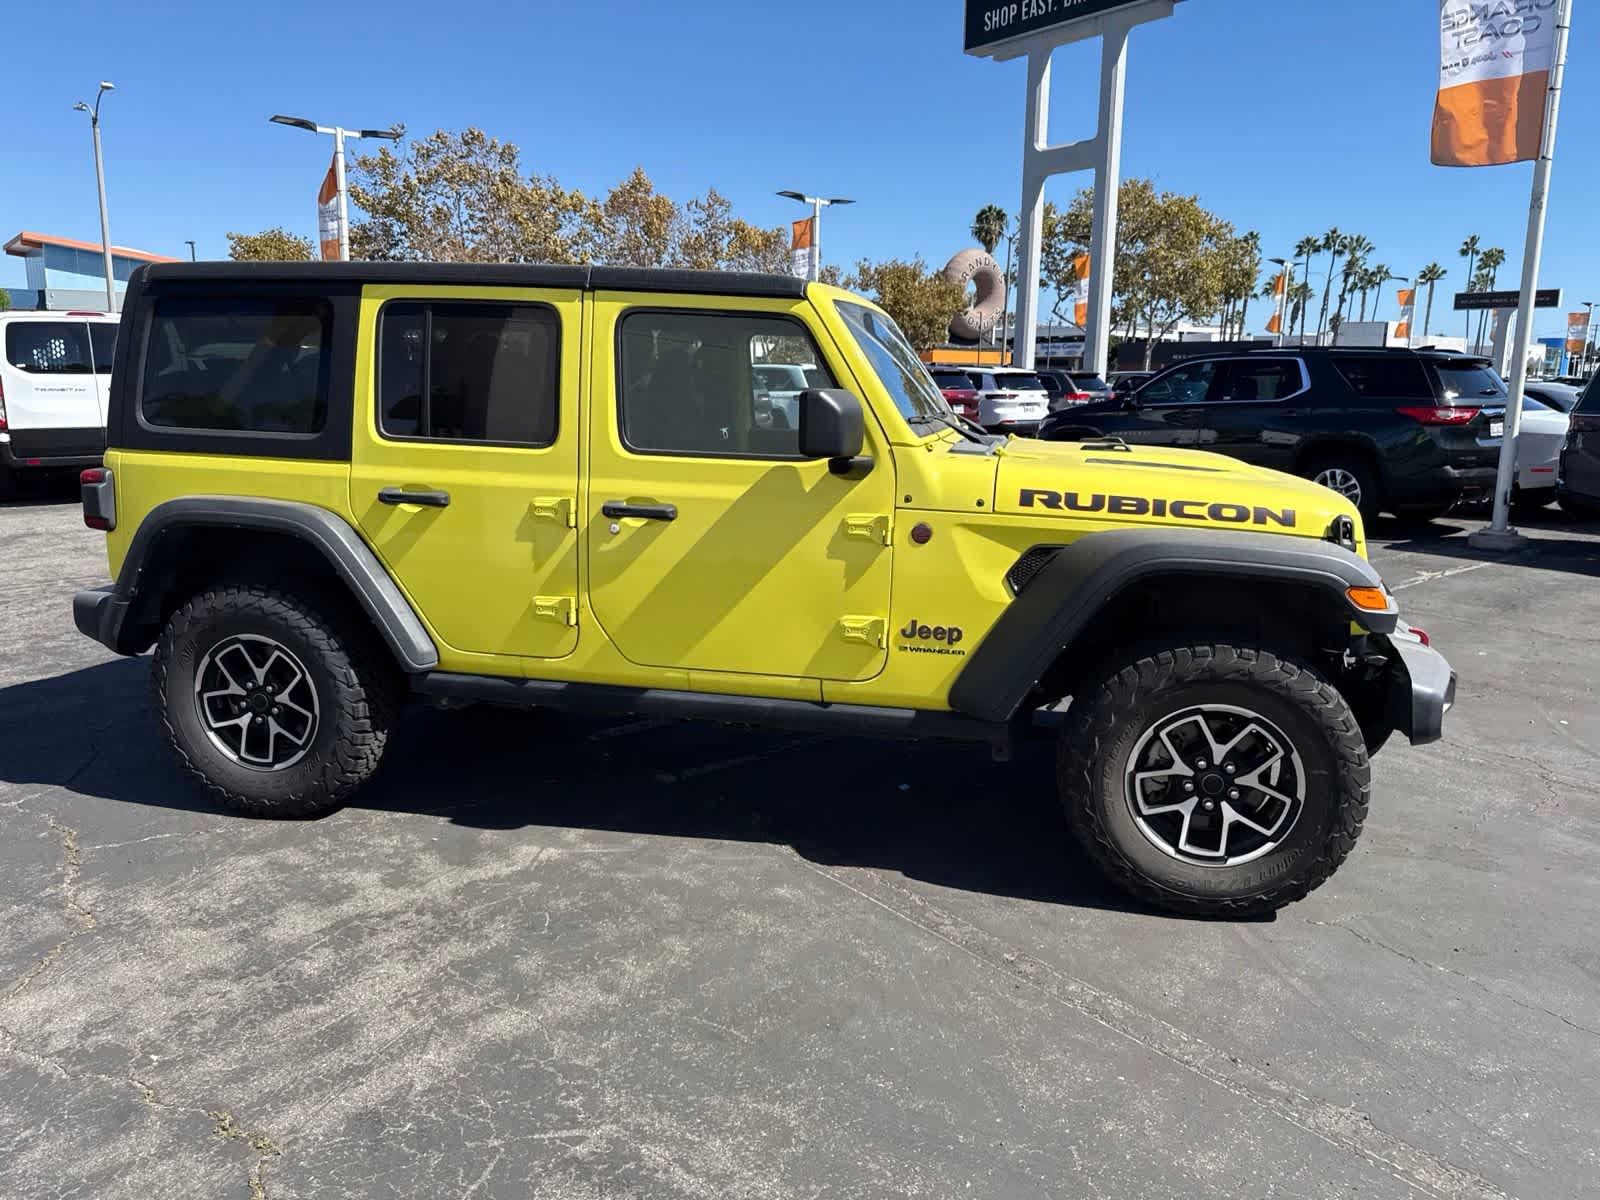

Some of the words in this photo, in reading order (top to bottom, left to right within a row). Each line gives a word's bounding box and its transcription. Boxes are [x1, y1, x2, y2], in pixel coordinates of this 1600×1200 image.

[984, 3, 1018, 32] SHOP
[1019, 488, 1296, 528] RUBICON
[900, 619, 963, 645] Jeep
[909, 647, 966, 657] WRANGLER
